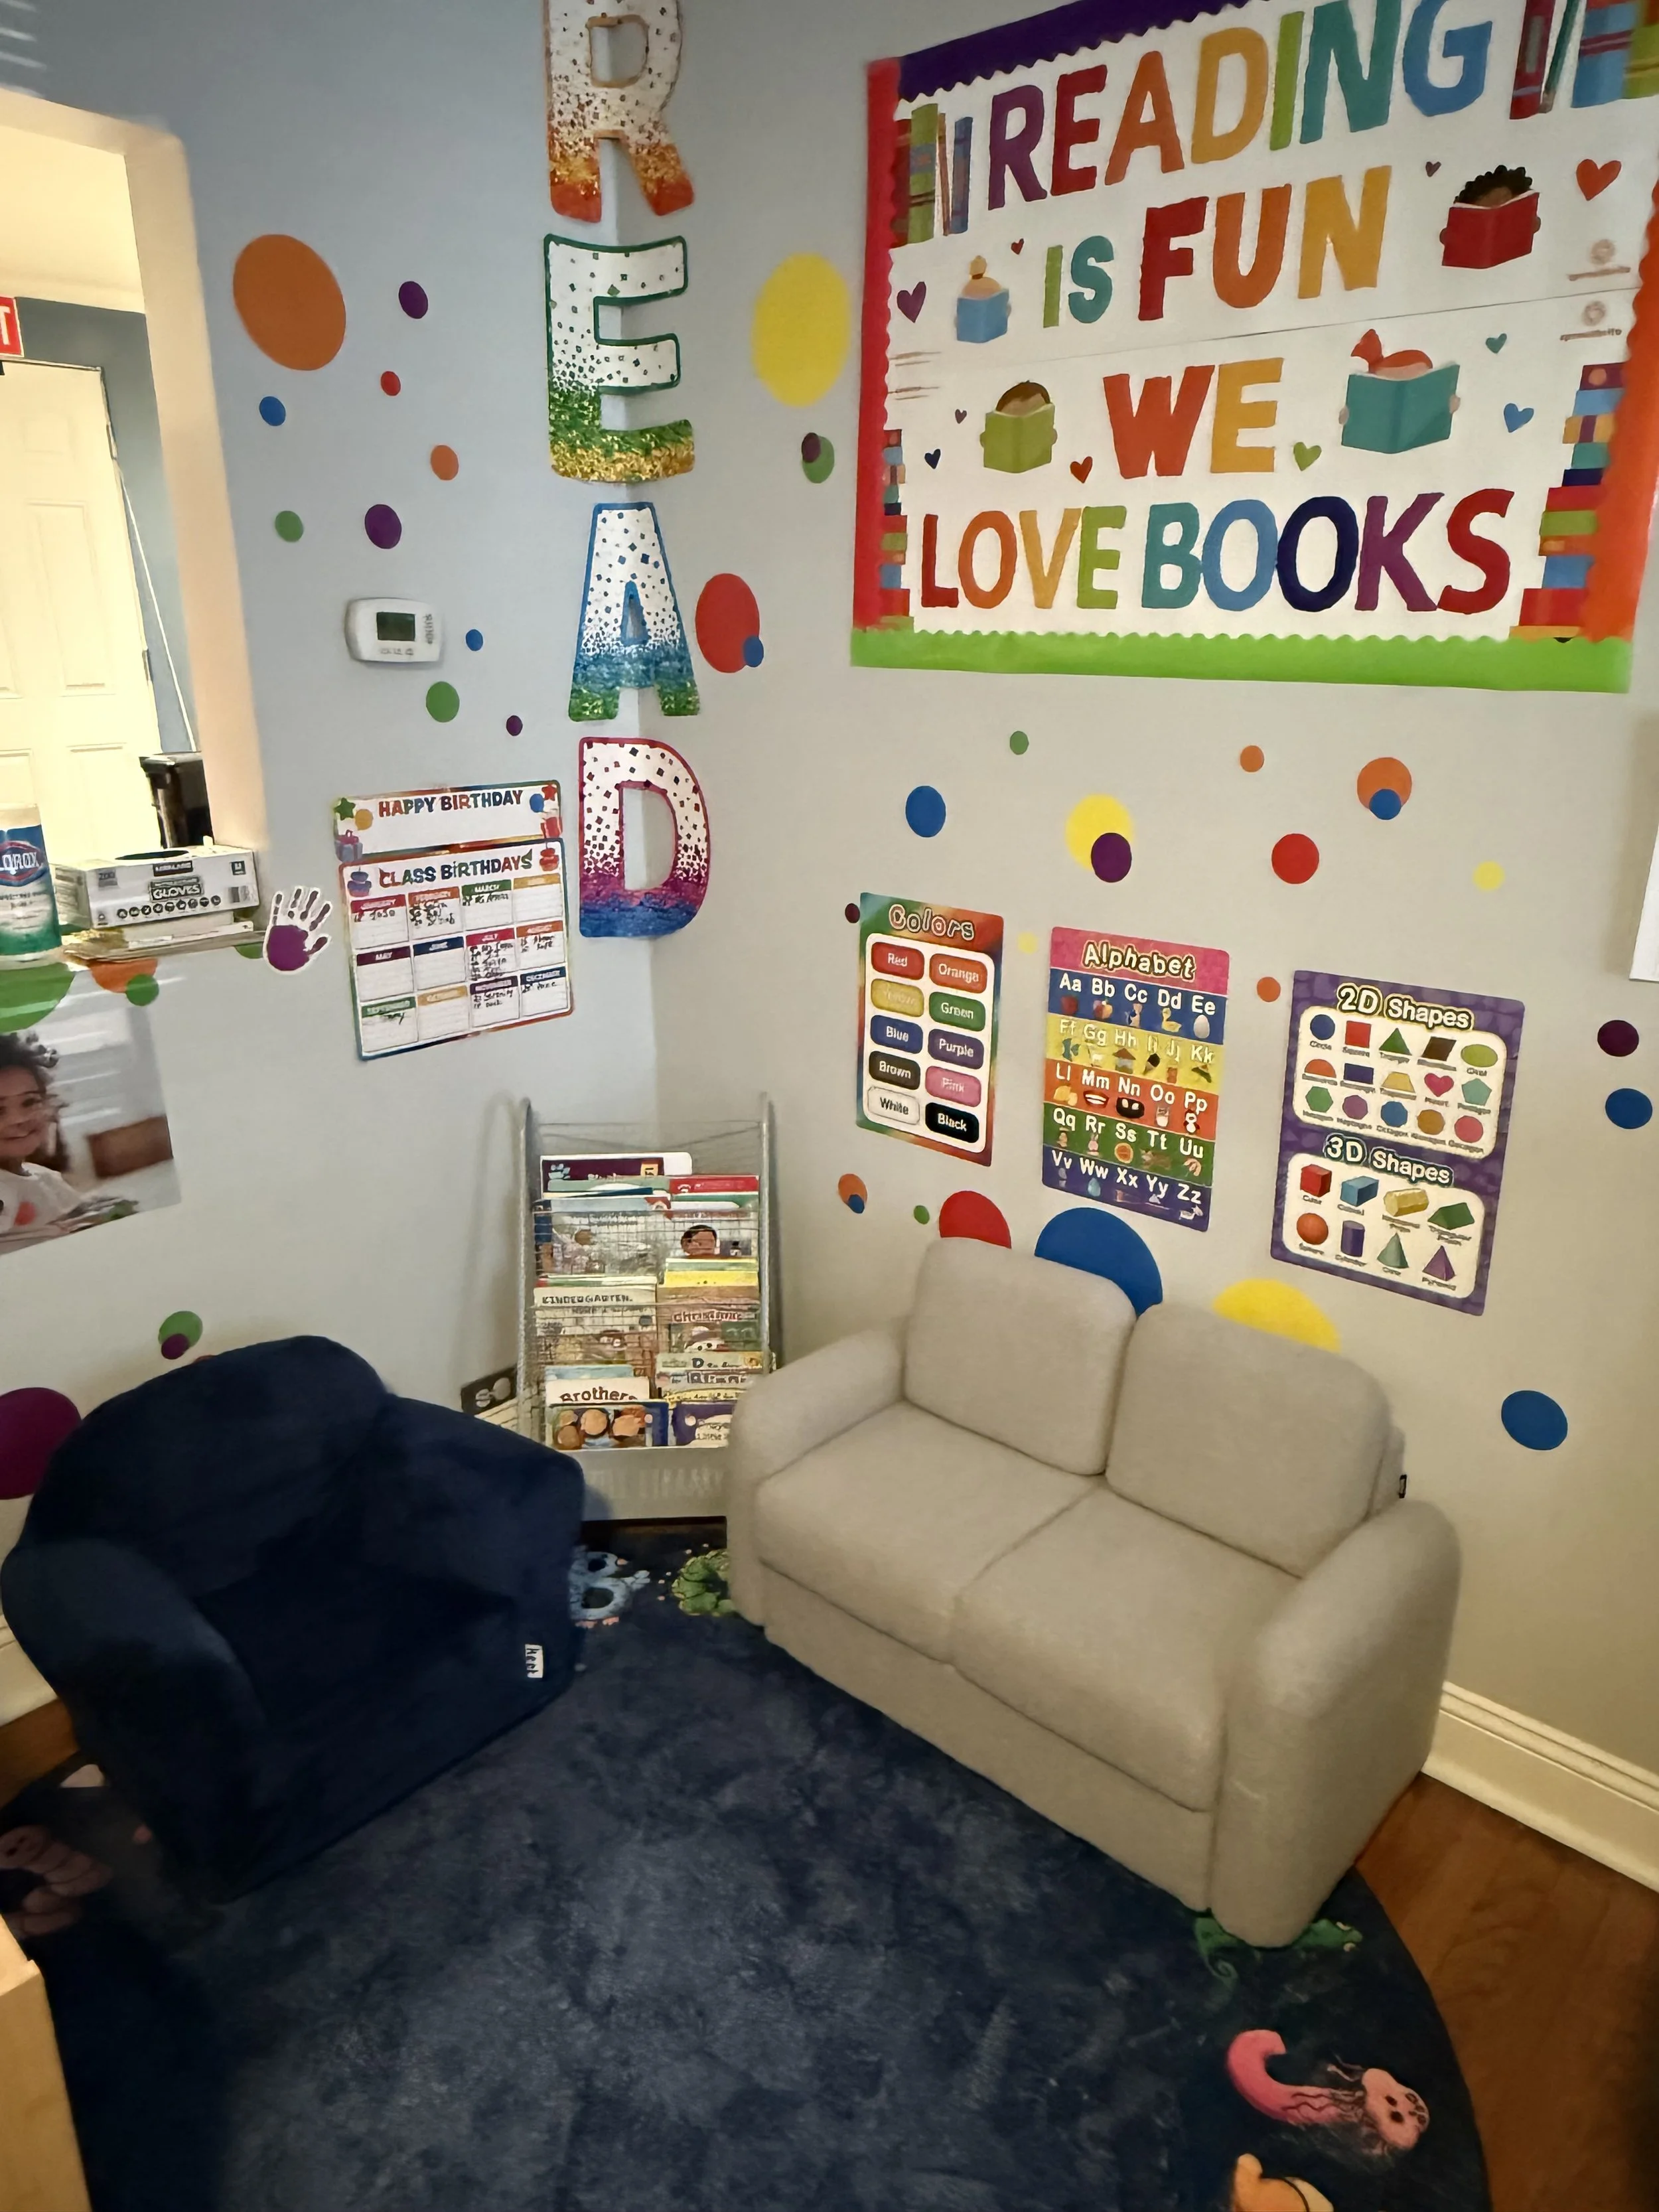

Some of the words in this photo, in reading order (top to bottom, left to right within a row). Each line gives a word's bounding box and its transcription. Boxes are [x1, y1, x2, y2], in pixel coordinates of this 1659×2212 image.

[987, 0, 1493, 210] READING
[1043, 236, 1114, 329] IS
[1138, 165, 1392, 321] FUN
[1102, 357, 1285, 479] WE
[920, 504, 1127, 611] LOVE
[1141, 488, 1516, 615] BOOKS
[378, 796, 436, 818] HAPPY
[441, 790, 524, 811] BIRTHDAY
[379, 868, 437, 888] CLASS
[441, 851, 533, 880] BIRTHDAYS
[153, 884, 200, 900] GLOVES
[889, 903, 975, 942] Colors
[1082, 941, 1196, 981] Alphabet
[1060, 973, 1082, 994] Aa
[1091, 978, 1116, 997] Bb
[1124, 983, 1148, 1003] Cc
[1157, 989, 1182, 1009] Dd
[1192, 995, 1216, 1016] Ee
[1338, 985, 1380, 1013] 2D
[1386, 999, 1472, 1029] Shapes
[886, 1026, 909, 1043] Blue
[939, 1038, 974, 1059] Purple
[1083, 1024, 1107, 1047] Gg
[879, 1061, 912, 1080] Brown
[1056, 1063, 1071, 1080] Ll
[1082, 1069, 1110, 1090] Mm
[1118, 1077, 1141, 1097] Nn
[1150, 1083, 1175, 1105] Oo
[1184, 1090, 1208, 1113] Pp
[880, 1098, 909, 1116] White
[938, 1112, 968, 1132] Black
[1052, 1108, 1076, 1132] Qq
[1086, 1114, 1106, 1134] Rr
[1115, 1123, 1137, 1142] Ss
[1147, 1130, 1167, 1151] Tt
[1180, 1138, 1204, 1159] Uu
[1052, 1149, 1072, 1170] Vv
[1080, 1157, 1108, 1180] Ww
[1116, 1167, 1138, 1189] Xx
[1146, 1174, 1169, 1199] Yy
[1177, 1183, 1202, 1206] Zz
[1326, 1136, 1364, 1163] 3D
[1372, 1150, 1451, 1184] Shapes
